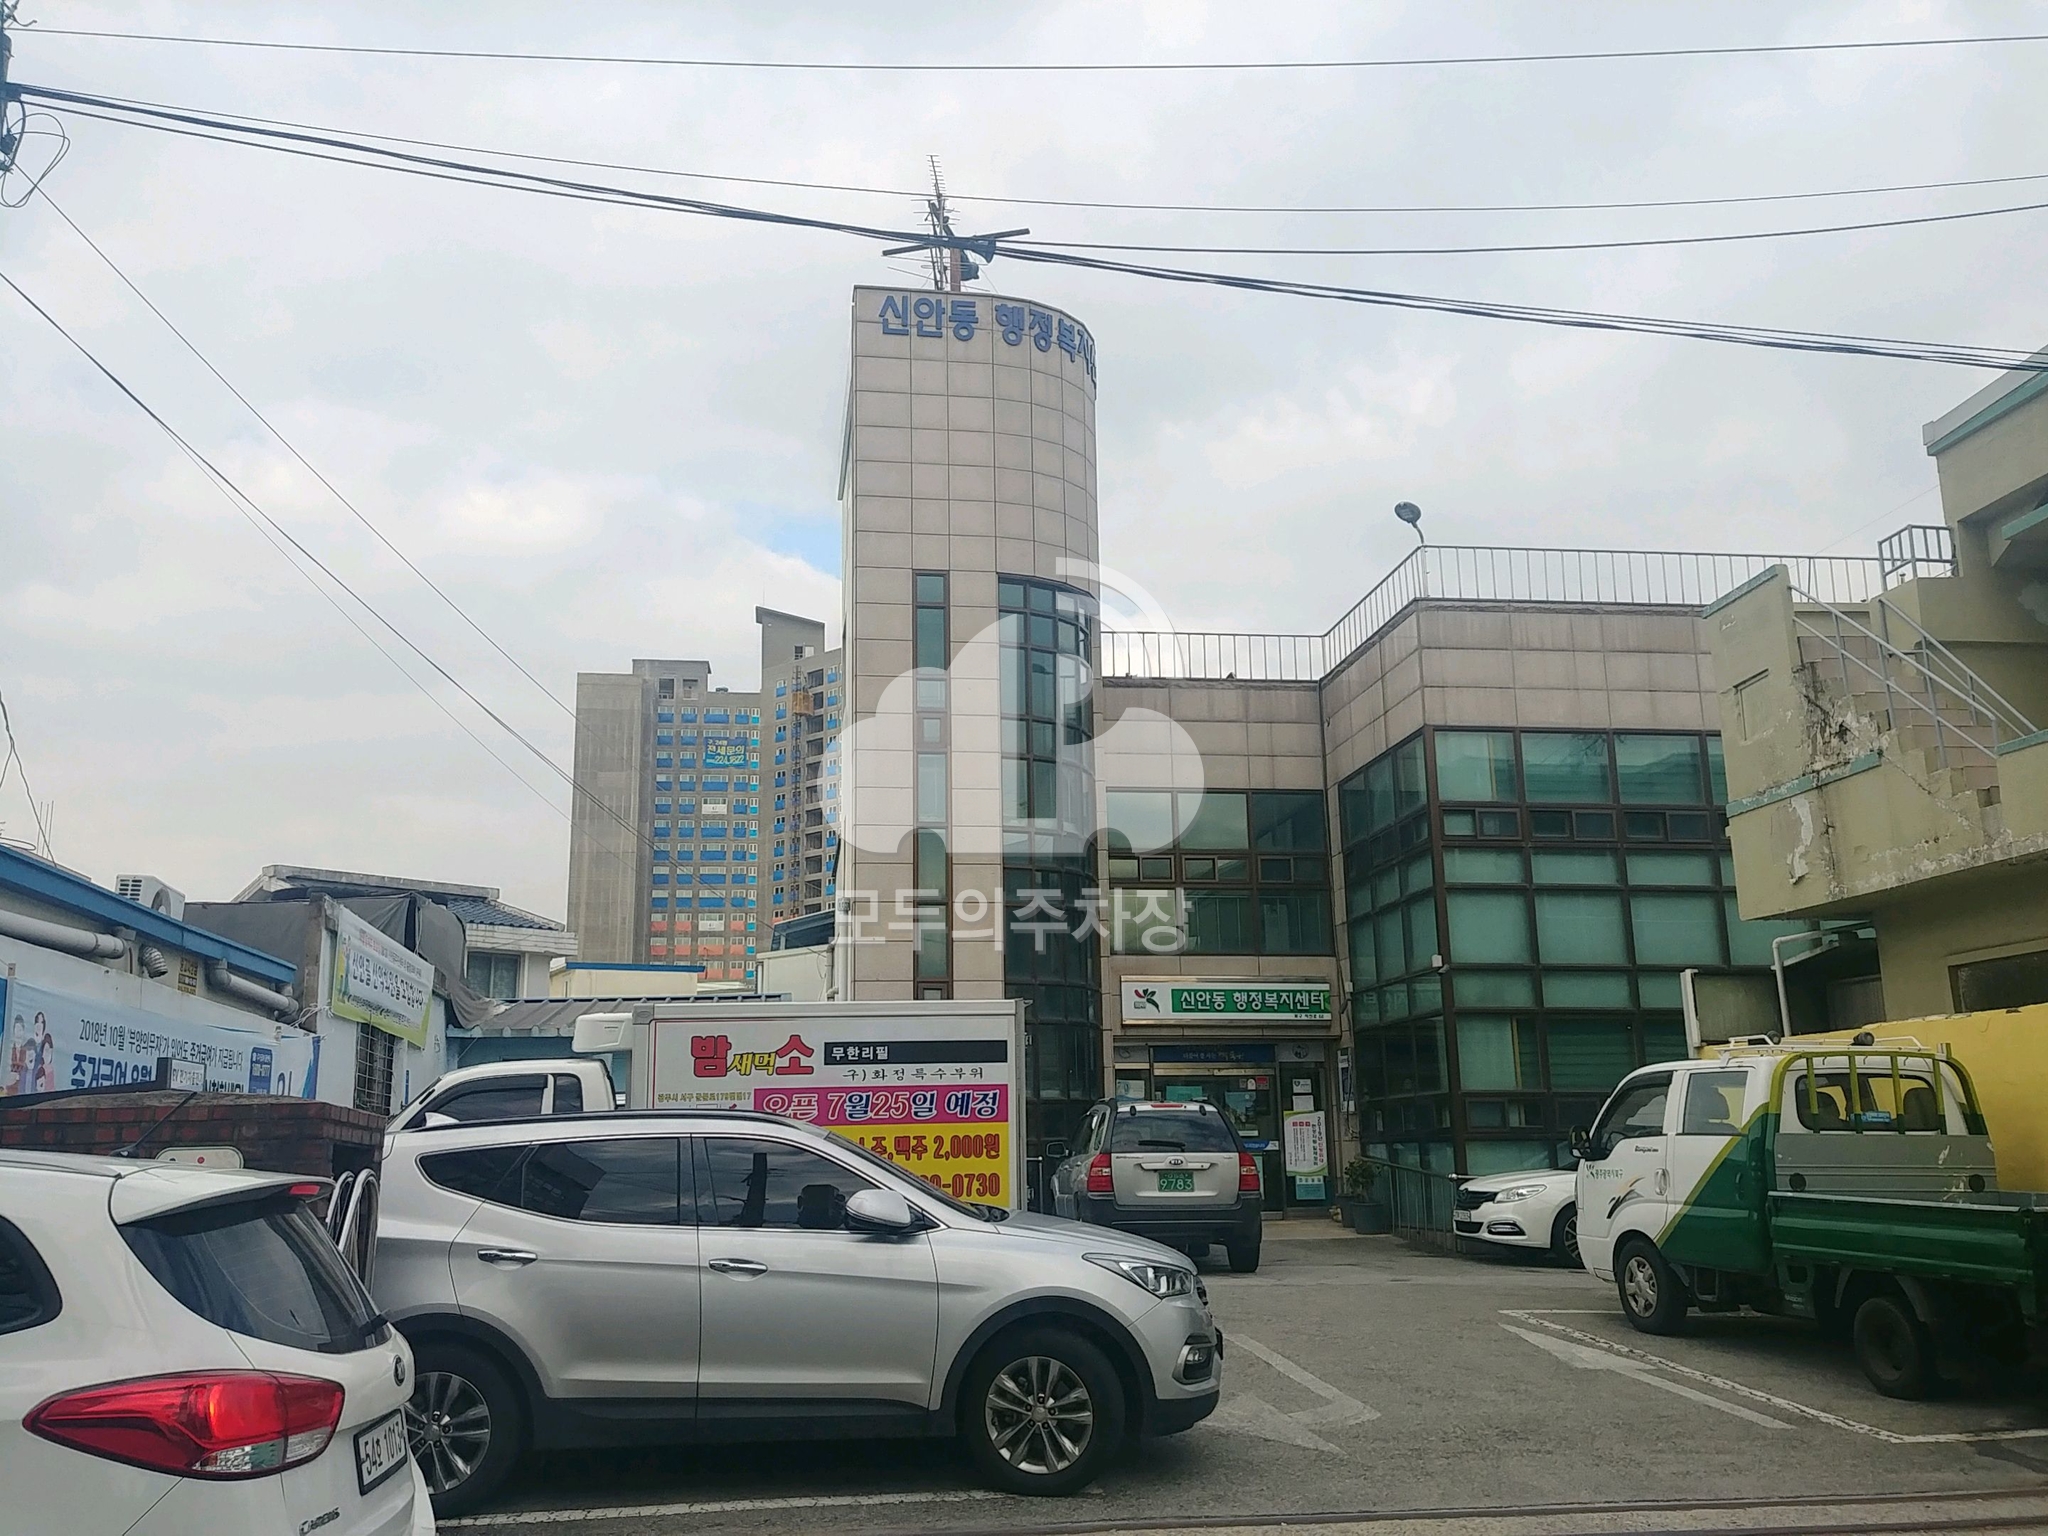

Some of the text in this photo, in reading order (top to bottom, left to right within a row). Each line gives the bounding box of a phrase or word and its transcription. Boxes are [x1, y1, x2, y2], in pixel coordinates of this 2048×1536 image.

[879, 296, 978, 341] 신안동
[1180, 991, 1325, 1010] 신안동 행정복지센터
[79, 1019, 107, 1047] 2018년
[109, 1025, 125, 1051] 10월
[831, 1045, 889, 1061] 무한리필
[763, 1089, 1000, 1123] 오픈 7월25일 예정
[858, 1134, 1000, 1161] 주,맥주 2,000원
[1160, 1178, 1192, 1190] 9783
